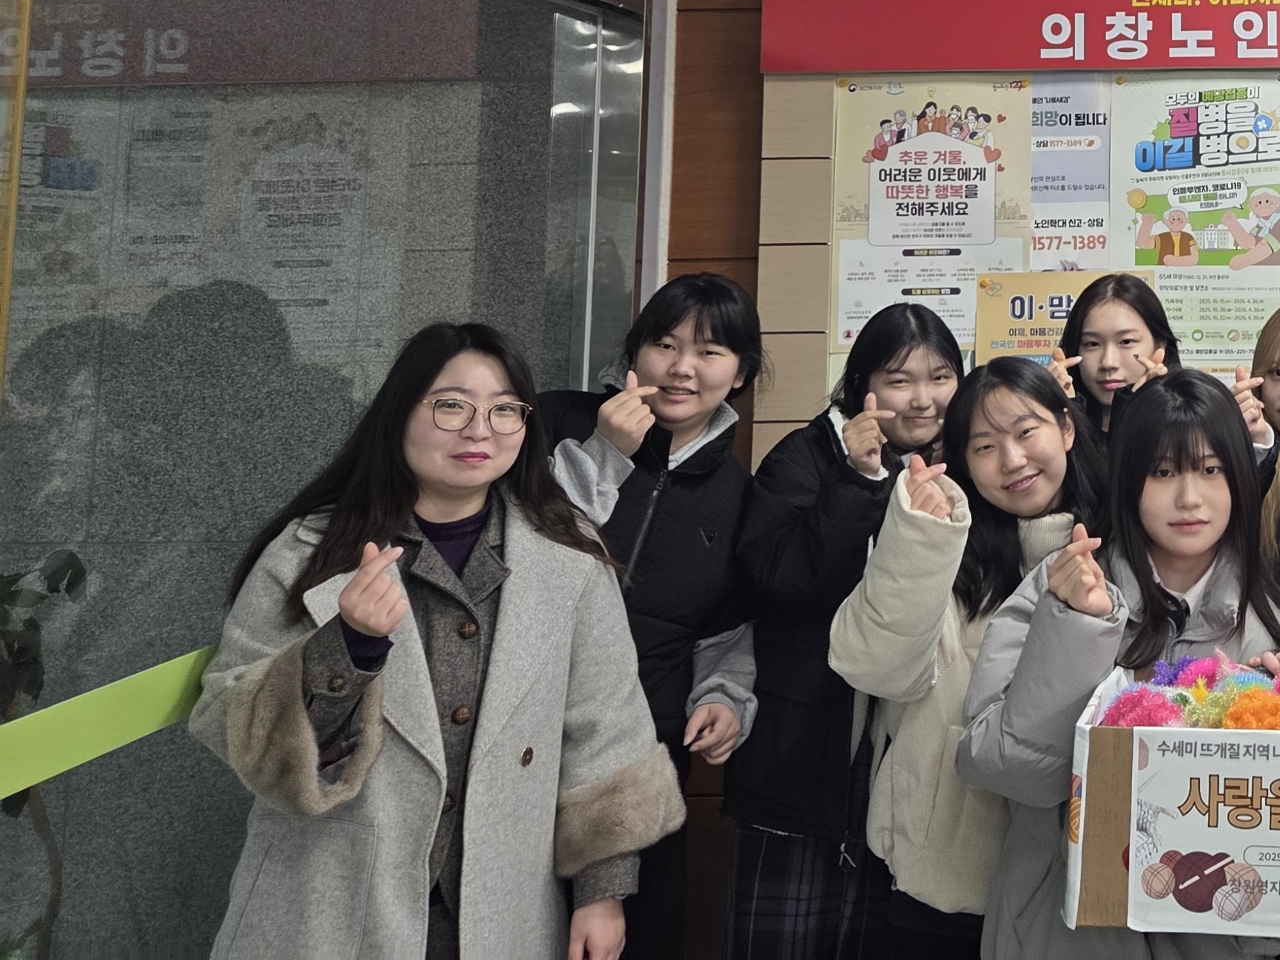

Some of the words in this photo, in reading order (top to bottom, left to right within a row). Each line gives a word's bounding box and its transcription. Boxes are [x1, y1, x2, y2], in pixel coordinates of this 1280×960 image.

[1165, 91, 1200, 106] 모두의
[1202, 86, 1260, 103] 예방접종이
[1031, 111, 1072, 127] 희망이
[1074, 113, 1107, 126] 됩니다
[1169, 101, 1259, 138] 질병을
[899, 150, 928, 166] 추운
[933, 150, 967, 166] 겨울,
[1135, 137, 1195, 172] 이길
[878, 168, 922, 182] 어려운
[927, 167, 987, 182] 이웃에게
[885, 184, 930, 200] 따뜻한
[935, 184, 979, 199] 행복을
[1172, 185, 1209, 196] 인플루엔자,
[1212, 182, 1242, 193] 코로나19
[895, 202, 969, 217] 전해주세요
[1034, 219, 1067, 229] 노인학대
[1031, 235, 1107, 251] 1577-1389
[1008, 328, 1028, 337] 이제,
[1017, 340, 1051, 349] 마음투자
[1157, 740, 1197, 757] 수세미
[1200, 742, 1240, 759] 뜨개질
[1243, 743, 1270, 761] 지역
